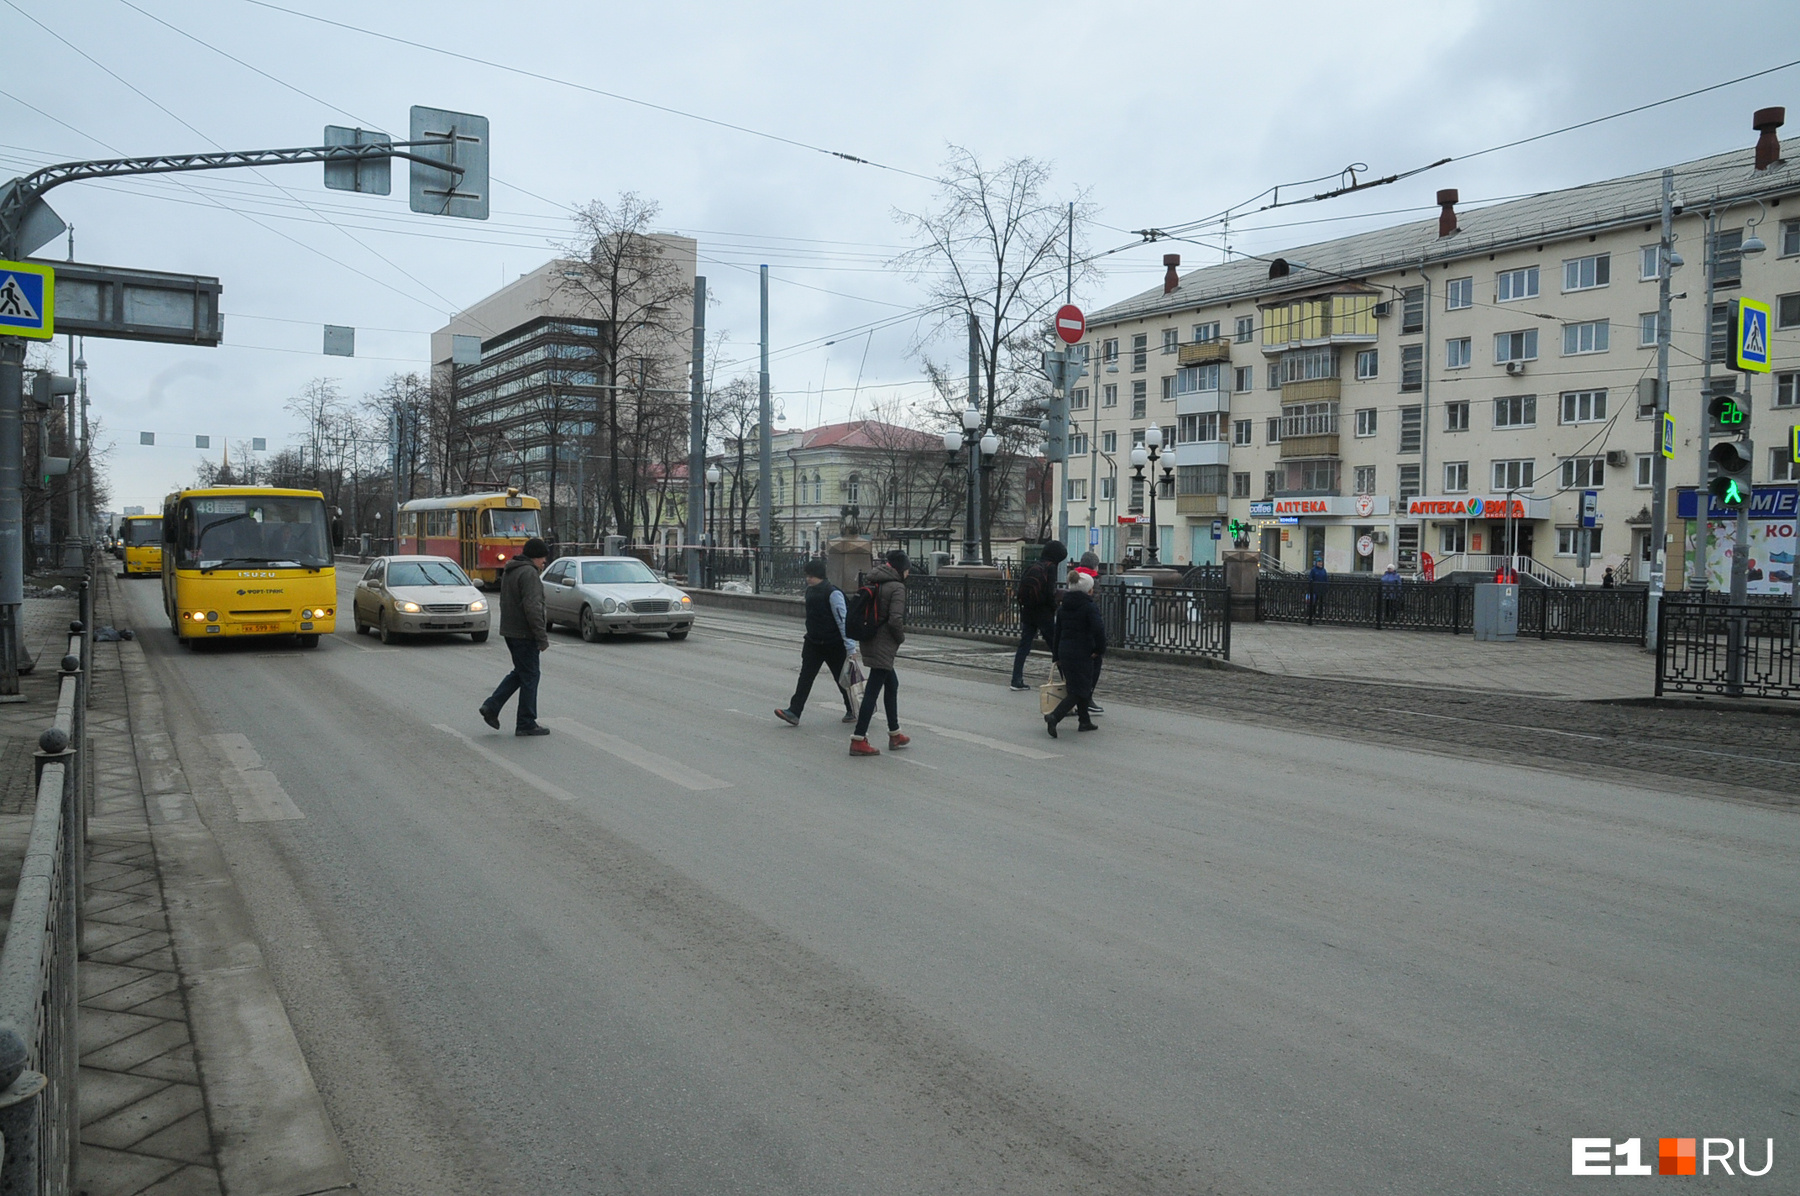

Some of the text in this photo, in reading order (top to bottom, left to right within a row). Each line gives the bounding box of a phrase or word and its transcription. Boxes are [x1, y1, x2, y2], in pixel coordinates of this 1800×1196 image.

[1720, 402, 1743, 424] 26
[196, 502, 214, 513] 48
[1249, 504, 1272, 513] coffee
[1275, 501, 1327, 513] АПТЕКА
[1409, 501, 1467, 514] АПТЕКА
